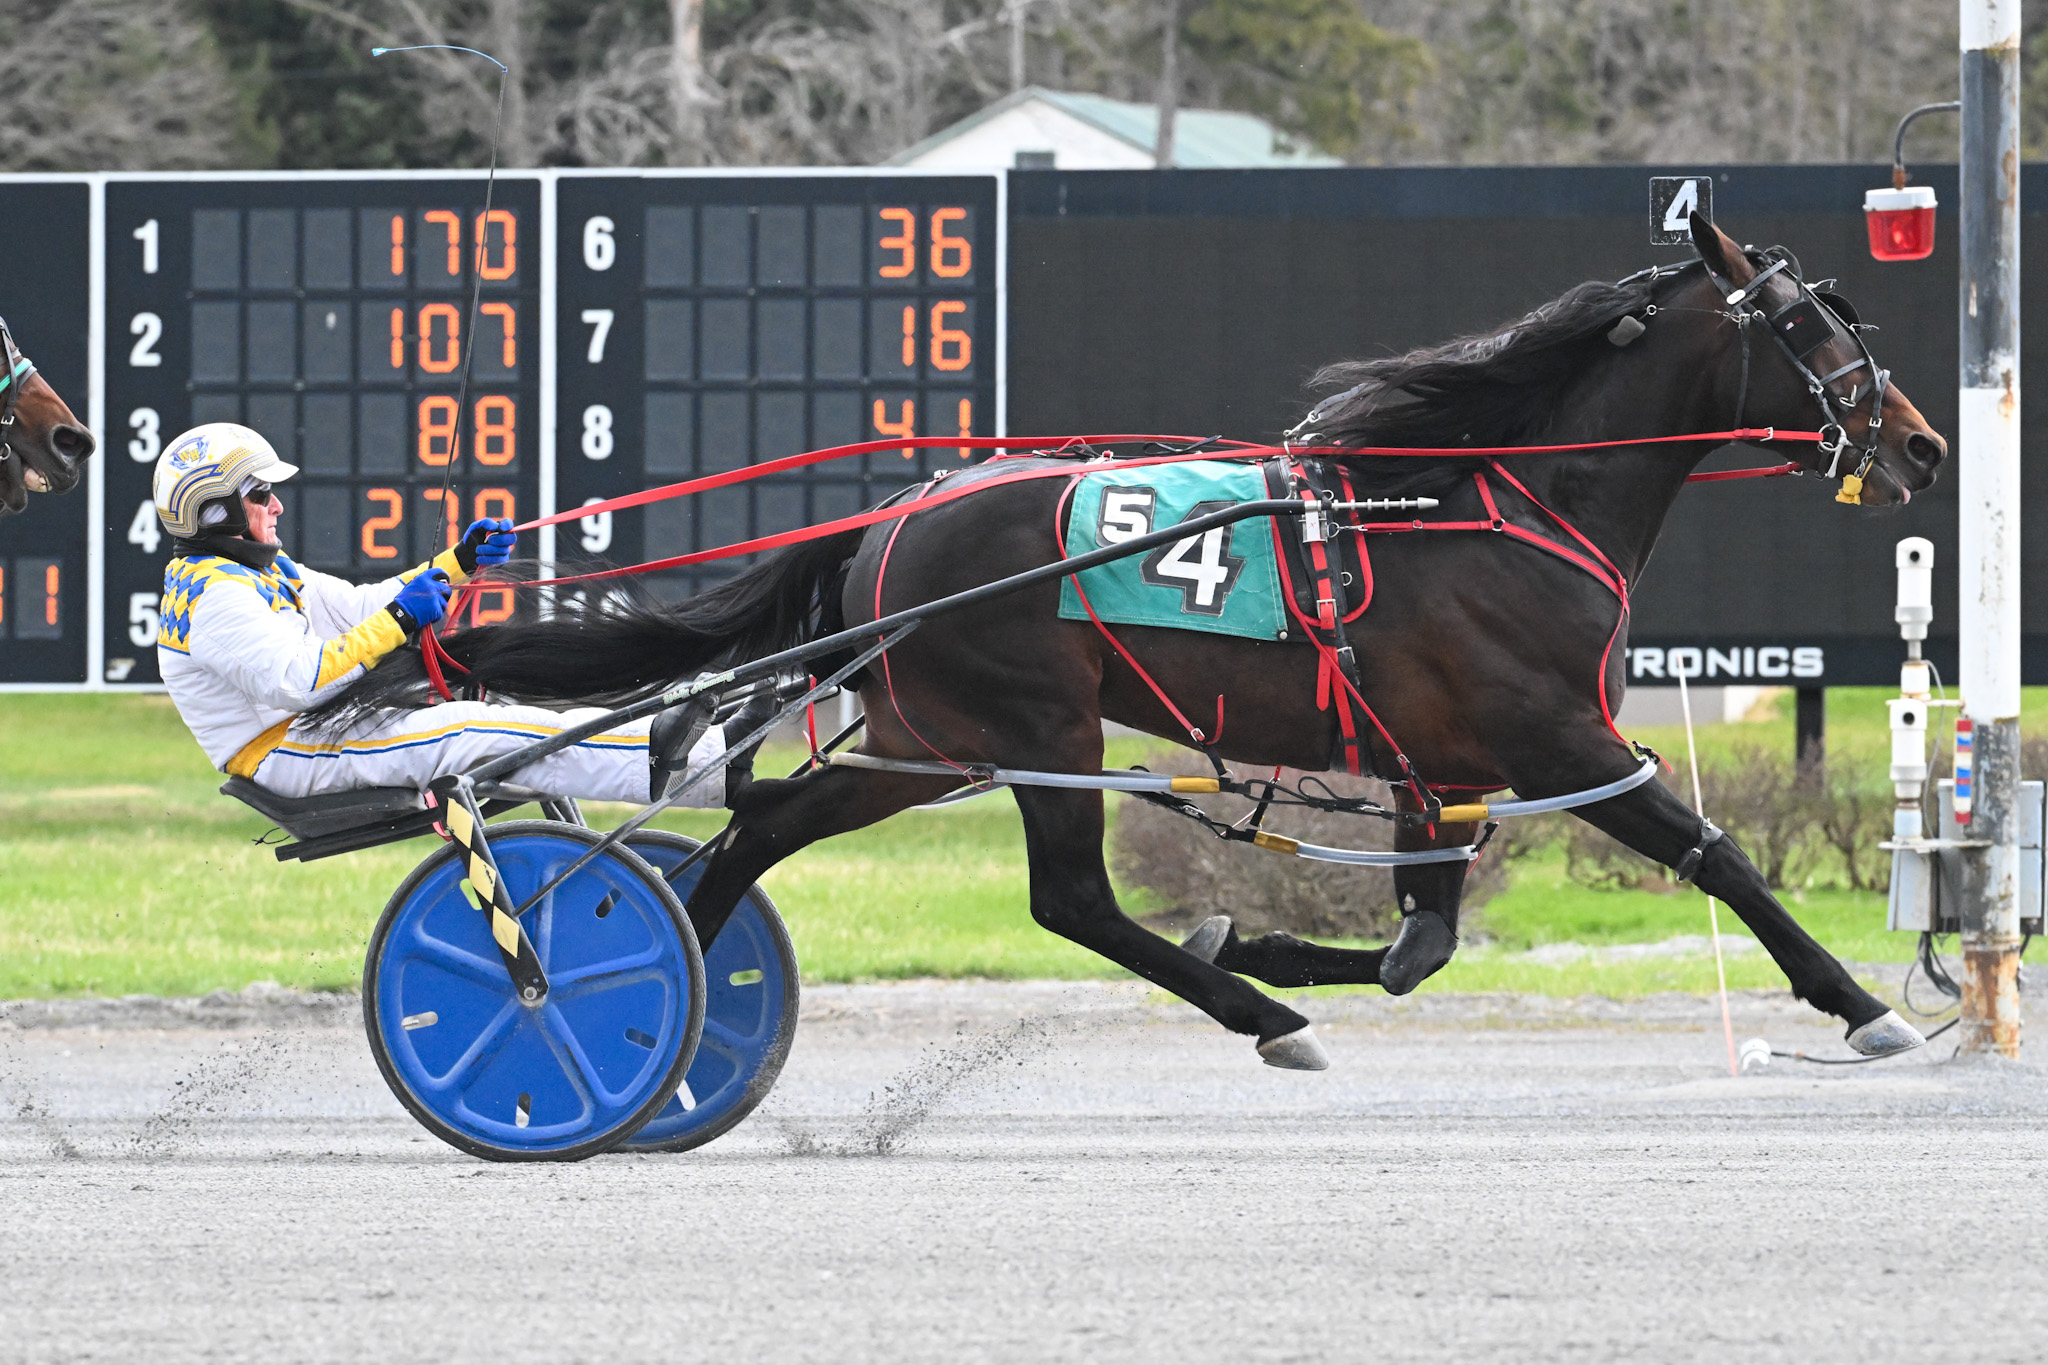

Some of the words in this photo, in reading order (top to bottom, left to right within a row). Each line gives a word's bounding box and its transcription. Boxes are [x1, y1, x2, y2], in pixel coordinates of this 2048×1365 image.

[1663, 179, 1698, 240] 4
[133, 219, 158, 274] 1
[391, 211, 516, 280] 170
[583, 216, 615, 271] 6
[879, 207, 971, 278] 36
[130, 312, 162, 367] 2
[391, 303, 516, 373] 107
[581, 309, 614, 363] 7
[902, 301, 971, 371] 16
[129, 408, 160, 463] 3
[418, 396, 515, 466] 88
[582, 405, 613, 460] 8
[873, 399, 971, 459] 41
[128, 501, 160, 553] 4
[581, 498, 612, 553] 9
[1102, 493, 1153, 545] 5
[1156, 513, 1228, 606] 4
[129, 592, 159, 647] 5
